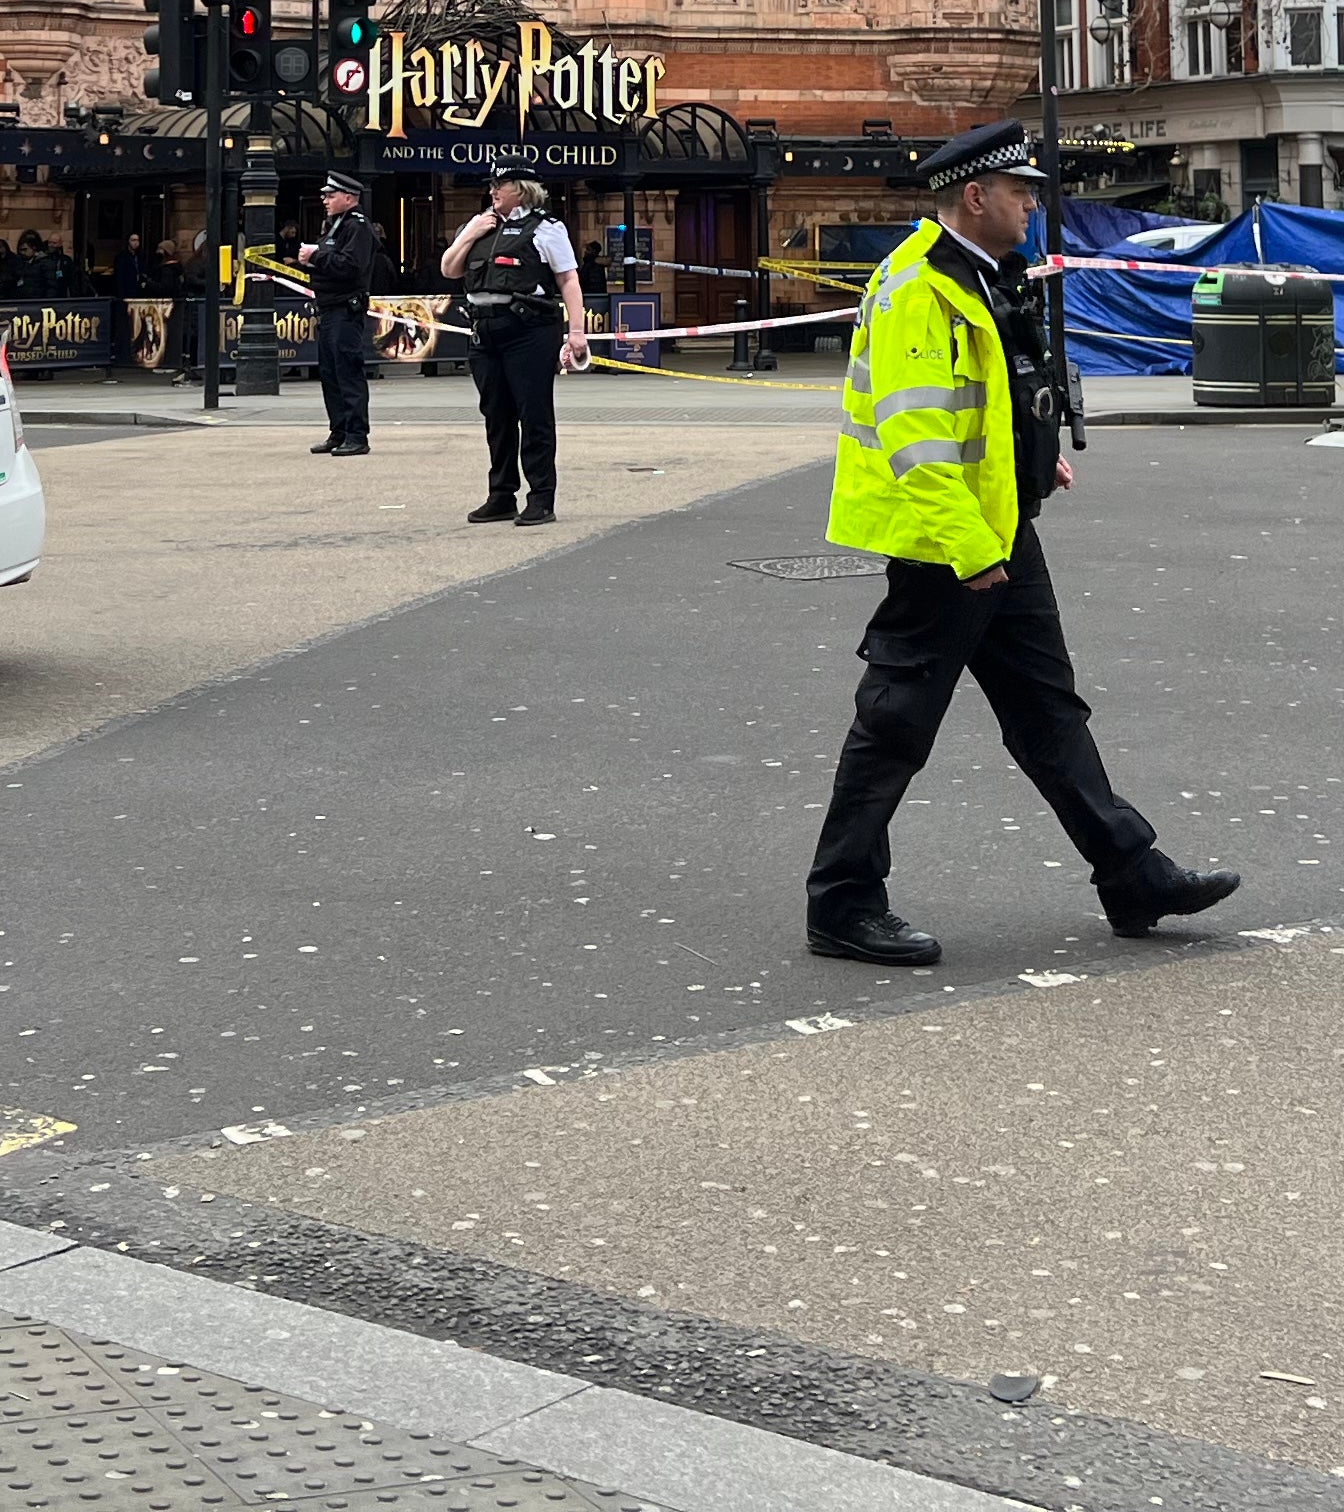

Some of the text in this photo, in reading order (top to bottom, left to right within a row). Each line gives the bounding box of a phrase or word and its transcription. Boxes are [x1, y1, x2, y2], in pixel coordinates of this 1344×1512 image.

[364, 21, 666, 143] Harry Potter
[1130, 119, 1167, 139] LIFE
[382, 146, 414, 160] AND
[418, 146, 445, 160] THE
[546, 145, 617, 166] CHILD
[41, 308, 100, 353] Potter
[6, 349, 78, 362] CURSED CHILD
